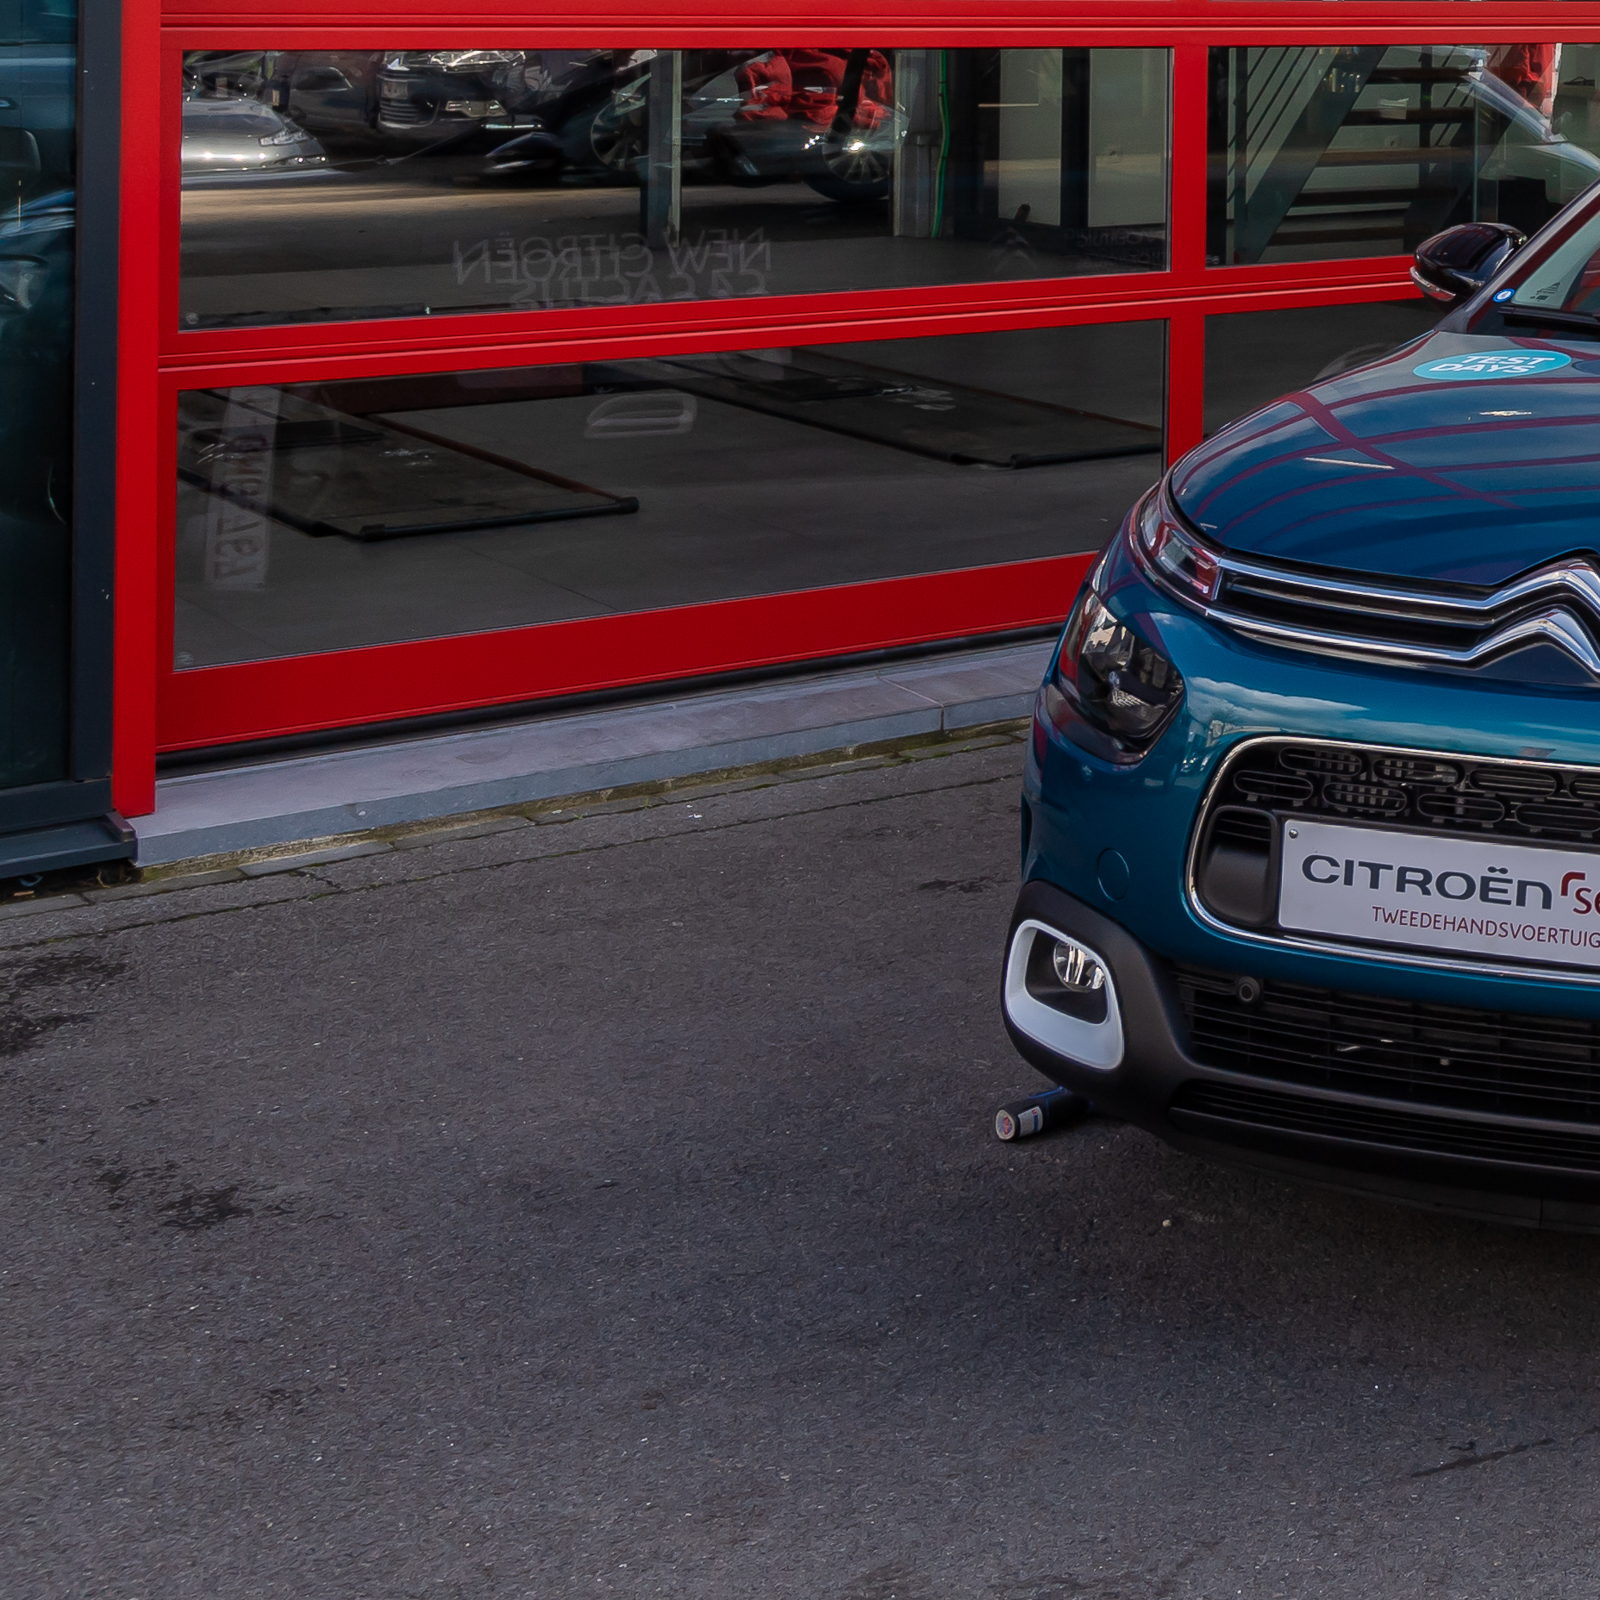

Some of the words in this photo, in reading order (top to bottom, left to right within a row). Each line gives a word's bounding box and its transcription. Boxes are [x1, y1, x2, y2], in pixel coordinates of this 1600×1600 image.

[1461, 355, 1555, 365] TEST
[1429, 364, 1536, 373] DAYS
[1301, 853, 1552, 910] CITROËN
